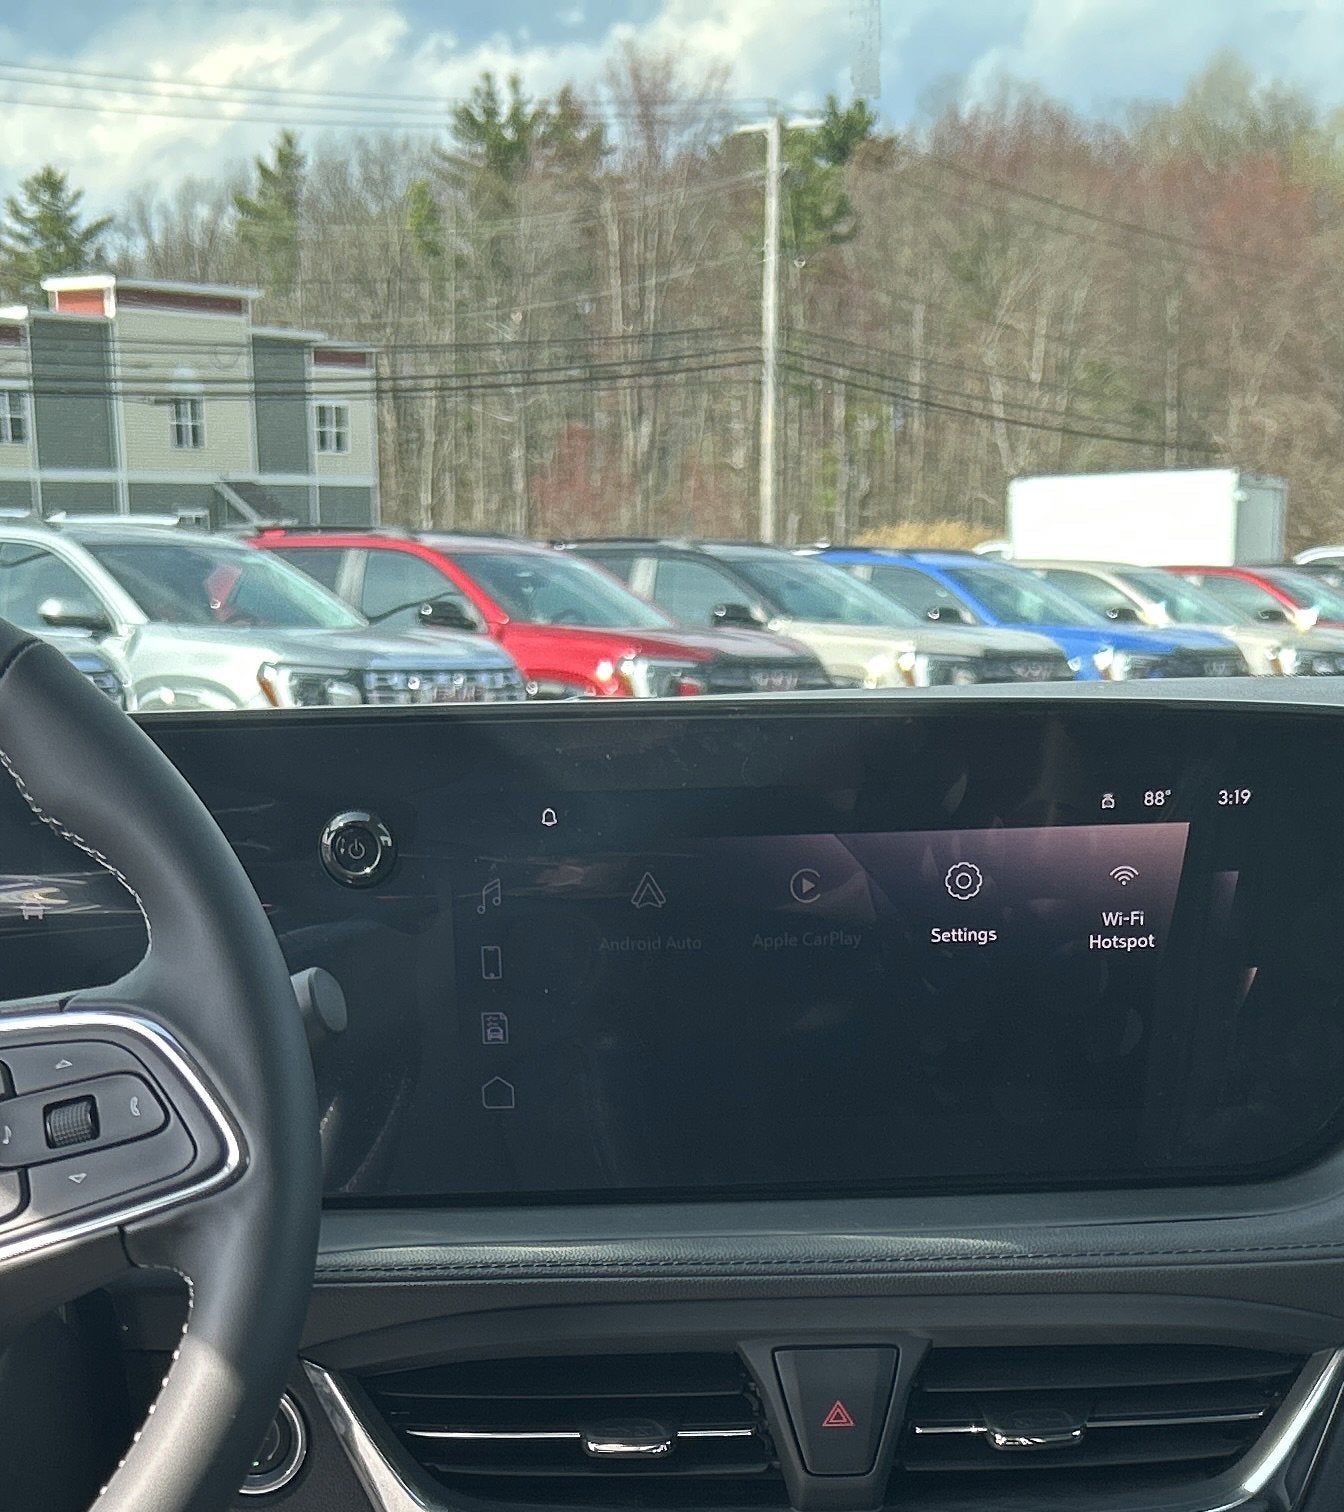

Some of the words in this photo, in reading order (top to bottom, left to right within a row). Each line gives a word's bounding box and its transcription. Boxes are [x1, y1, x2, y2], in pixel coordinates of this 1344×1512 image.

[1217, 789, 1251, 806] 3:19
[1102, 910, 1145, 926] Wi-Fi
[599, 934, 661, 952] Android
[666, 934, 702, 951] Auto
[752, 932, 798, 949] Apple
[802, 929, 862, 948] CarPlay
[930, 928, 997, 945] Settings
[1089, 933, 1155, 951] Hotspot
